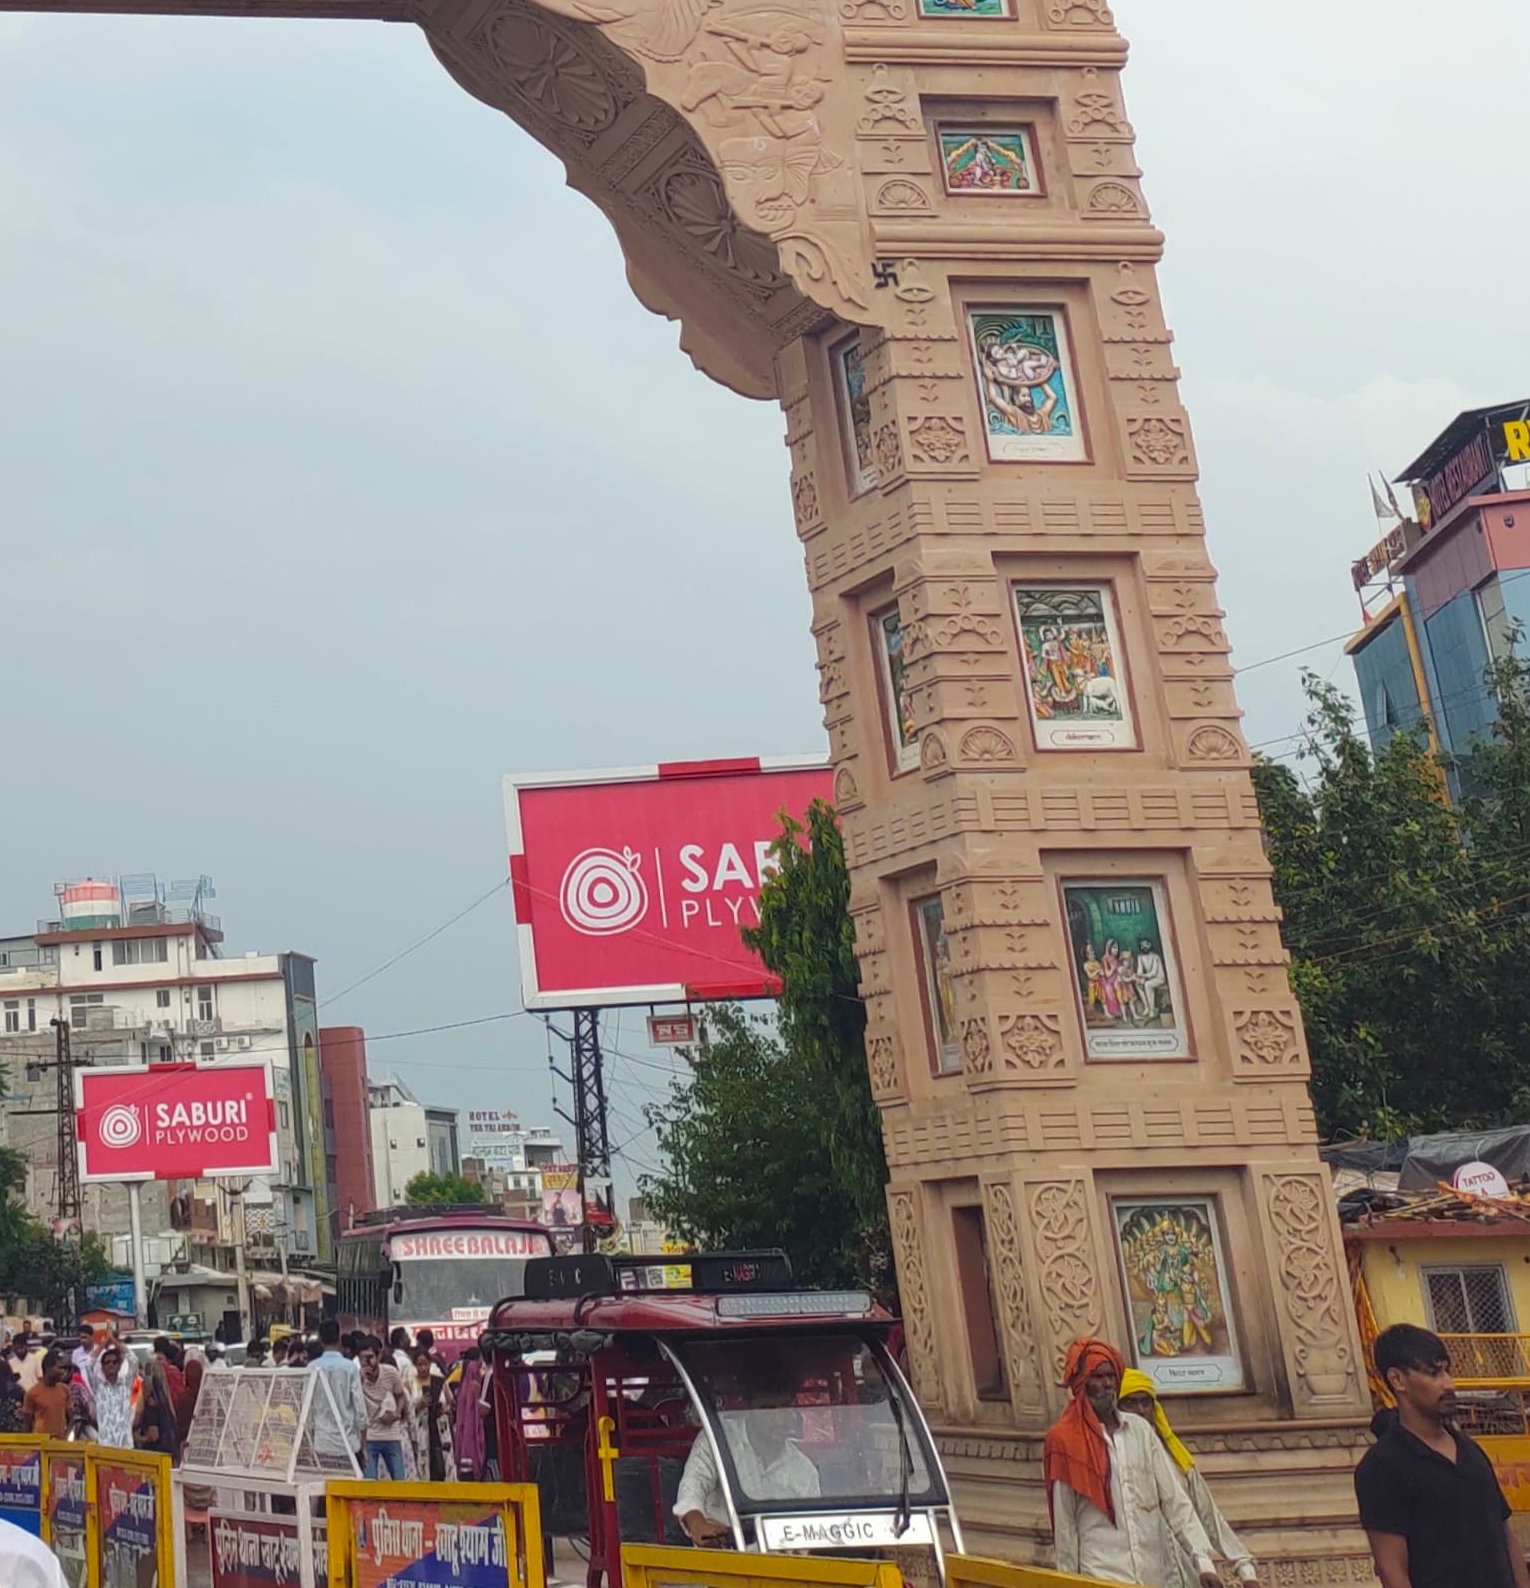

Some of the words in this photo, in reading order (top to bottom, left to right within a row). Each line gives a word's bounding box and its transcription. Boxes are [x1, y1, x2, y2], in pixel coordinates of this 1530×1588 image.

[679, 841, 786, 893] SAB
[156, 1099, 247, 1128] SABURI
[156, 1126, 249, 1146] PLYWOOD
[1462, 1172, 1495, 1188] TATTOO
[402, 1236, 464, 1257] SHREE
[467, 1235, 534, 1256] BALAJI
